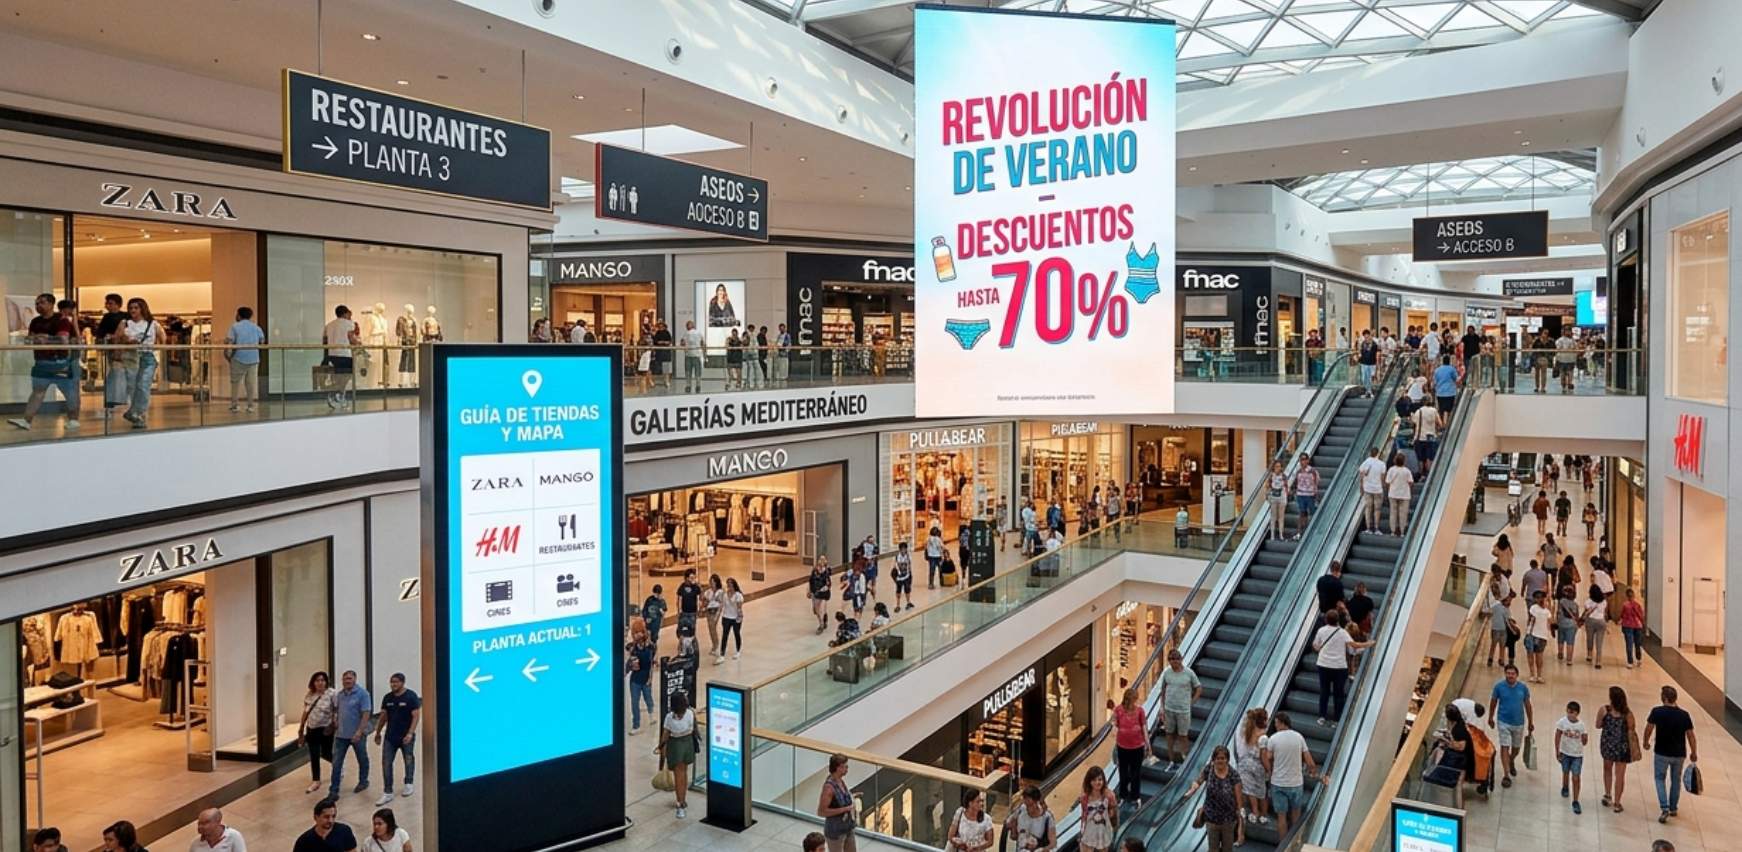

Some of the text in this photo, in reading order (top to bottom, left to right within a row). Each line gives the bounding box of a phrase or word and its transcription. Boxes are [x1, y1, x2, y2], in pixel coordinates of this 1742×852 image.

[311, 88, 508, 158] RESTAURANTES
[942, 72, 1148, 146] REVOLUCIÓN
[348, 139, 451, 182] PLANTA 3
[953, 129, 1138, 196] DE VERANO
[100, 183, 237, 221] ZARA
[700, 174, 744, 204] ASEOS
[736, 210, 745, 229] B
[957, 204, 1134, 260] DESCUENTOS
[1453, 237, 1515, 254] ACCESO B
[560, 261, 632, 279] MANGO
[1182, 268, 1240, 289] fnac
[957, 257, 1130, 349] HASTA 70%
[460, 404, 600, 425] GUÍA DE TIENDAS
[630, 390, 868, 436] GALERÍAS MEDITERRÁNEO
[501, 424, 564, 442] Y MAPA
[471, 476, 523, 491] ZARA
[539, 471, 594, 486] MANGO
[119, 537, 224, 583] ZARA
[472, 623, 592, 654] PLANTA ACTUAL: 1
